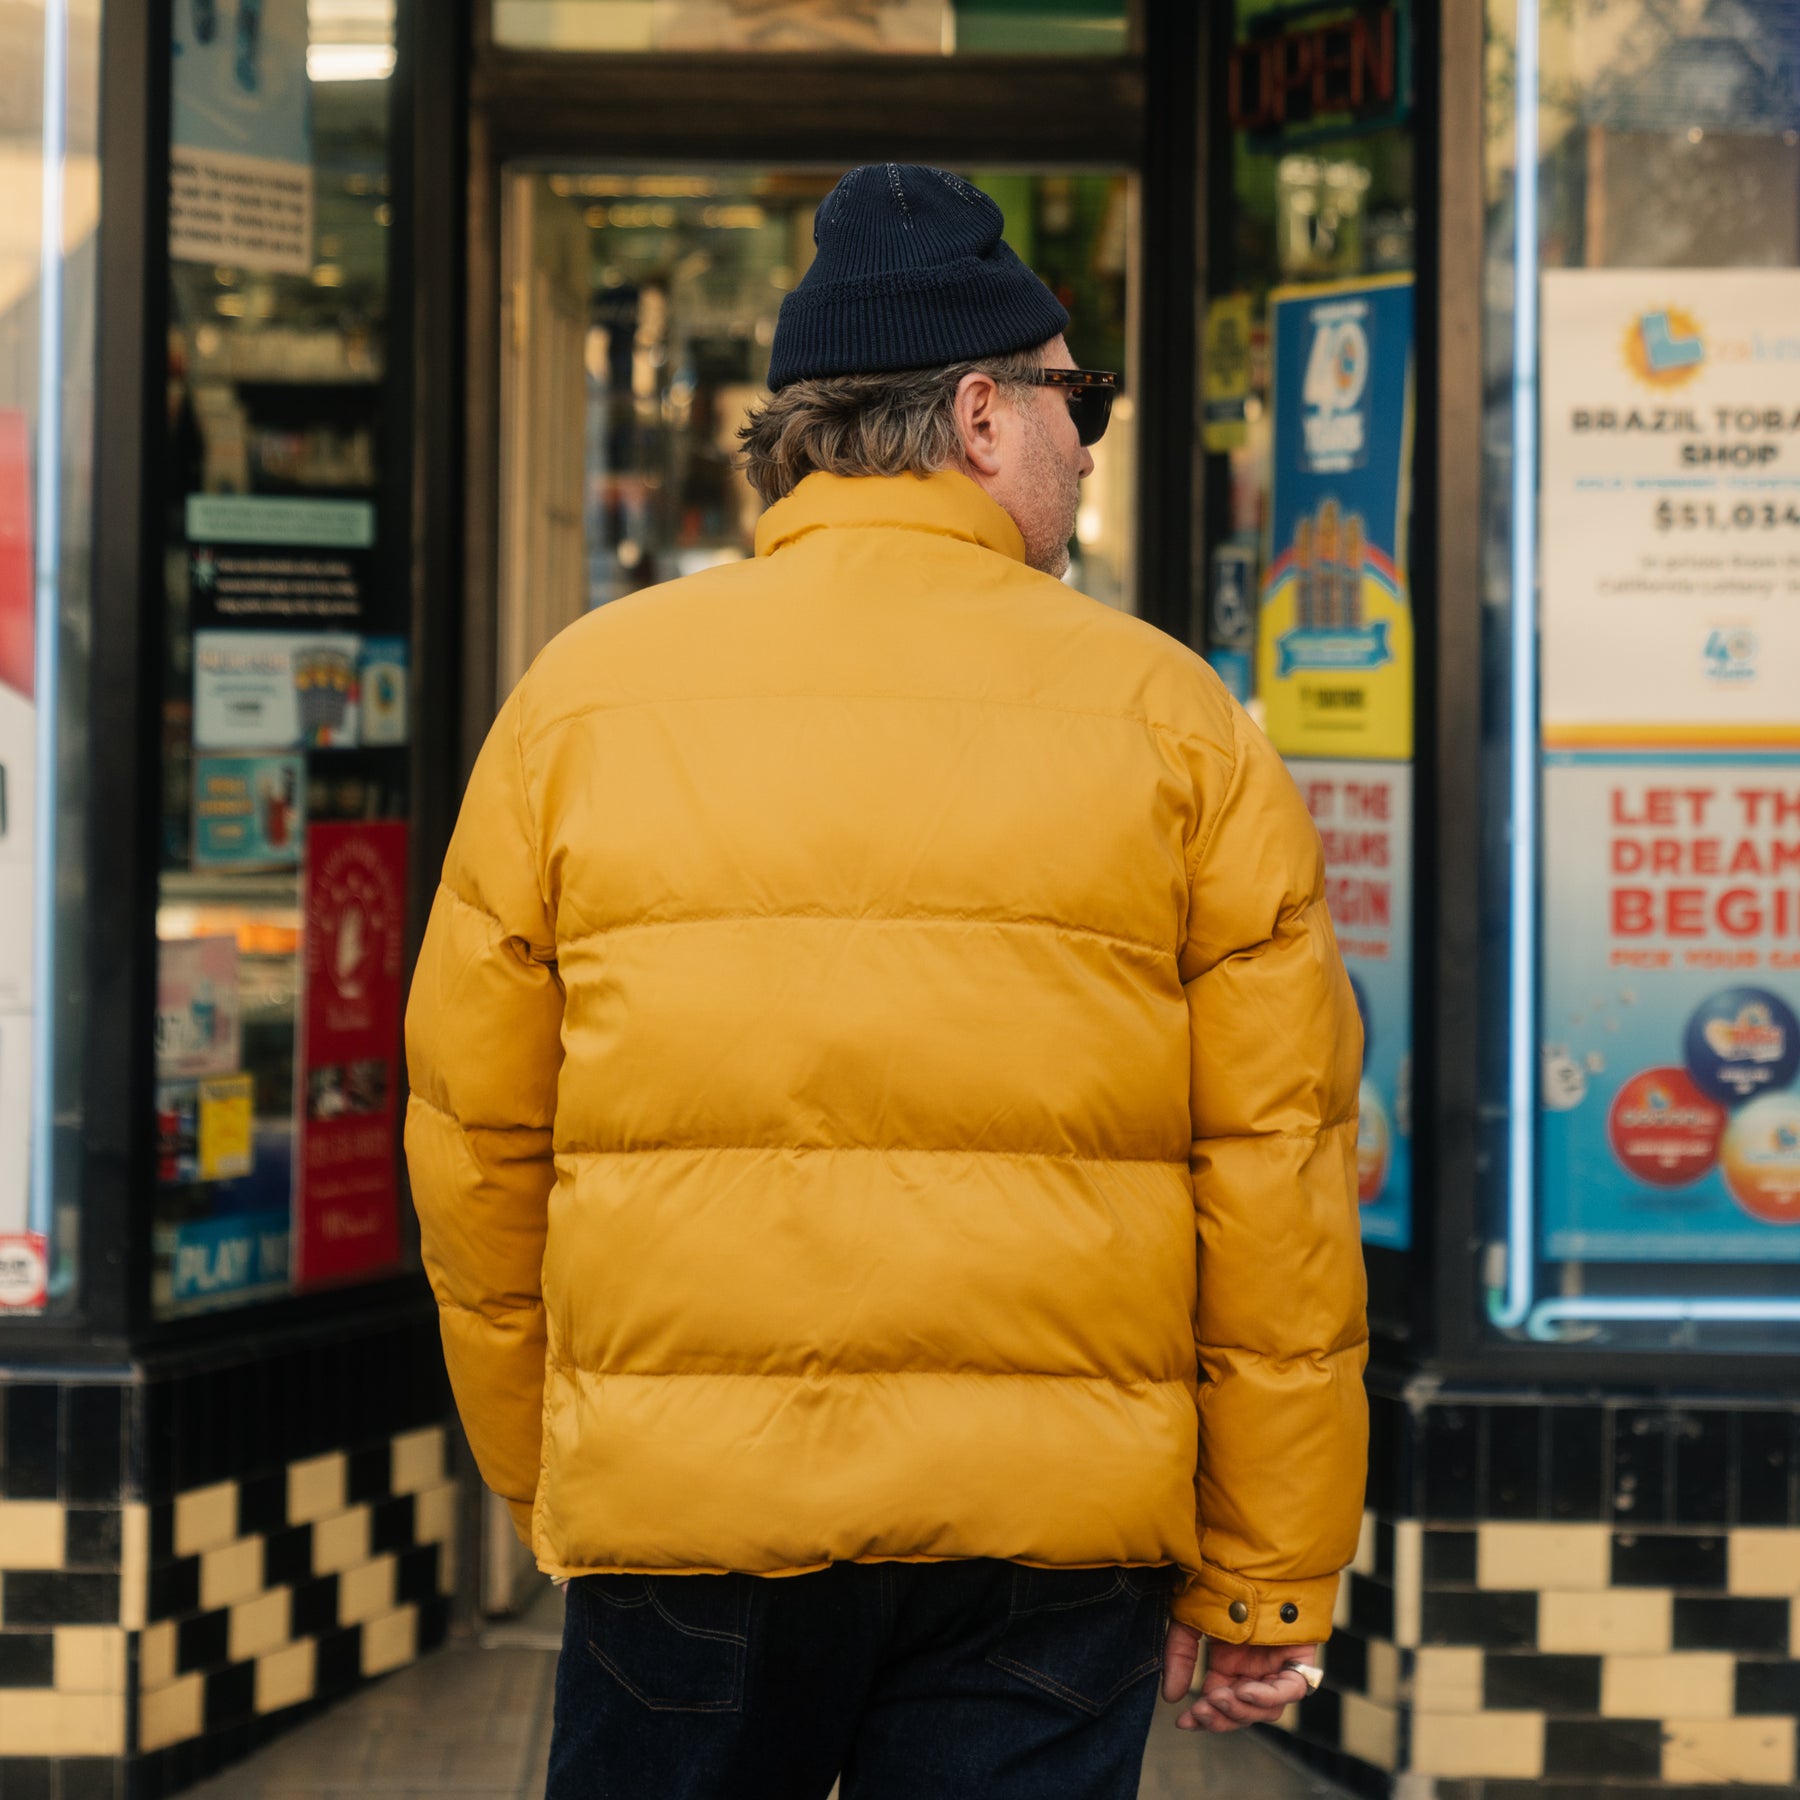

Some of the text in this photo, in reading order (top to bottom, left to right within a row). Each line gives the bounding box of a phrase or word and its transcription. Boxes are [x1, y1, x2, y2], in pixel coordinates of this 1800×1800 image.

[1228, 8, 1393, 131] OPEN
[1571, 407, 1702, 433] BRAZIL
[1680, 441, 1779, 468] SHOP
[1345, 778, 1390, 822] THE
[1611, 786, 1715, 827] LET
[1320, 828, 1390, 869] EAMS
[1611, 836, 1800, 876] DREAM
[1611, 886, 1800, 940] BEGI
[175, 1236, 255, 1292] PLAY
